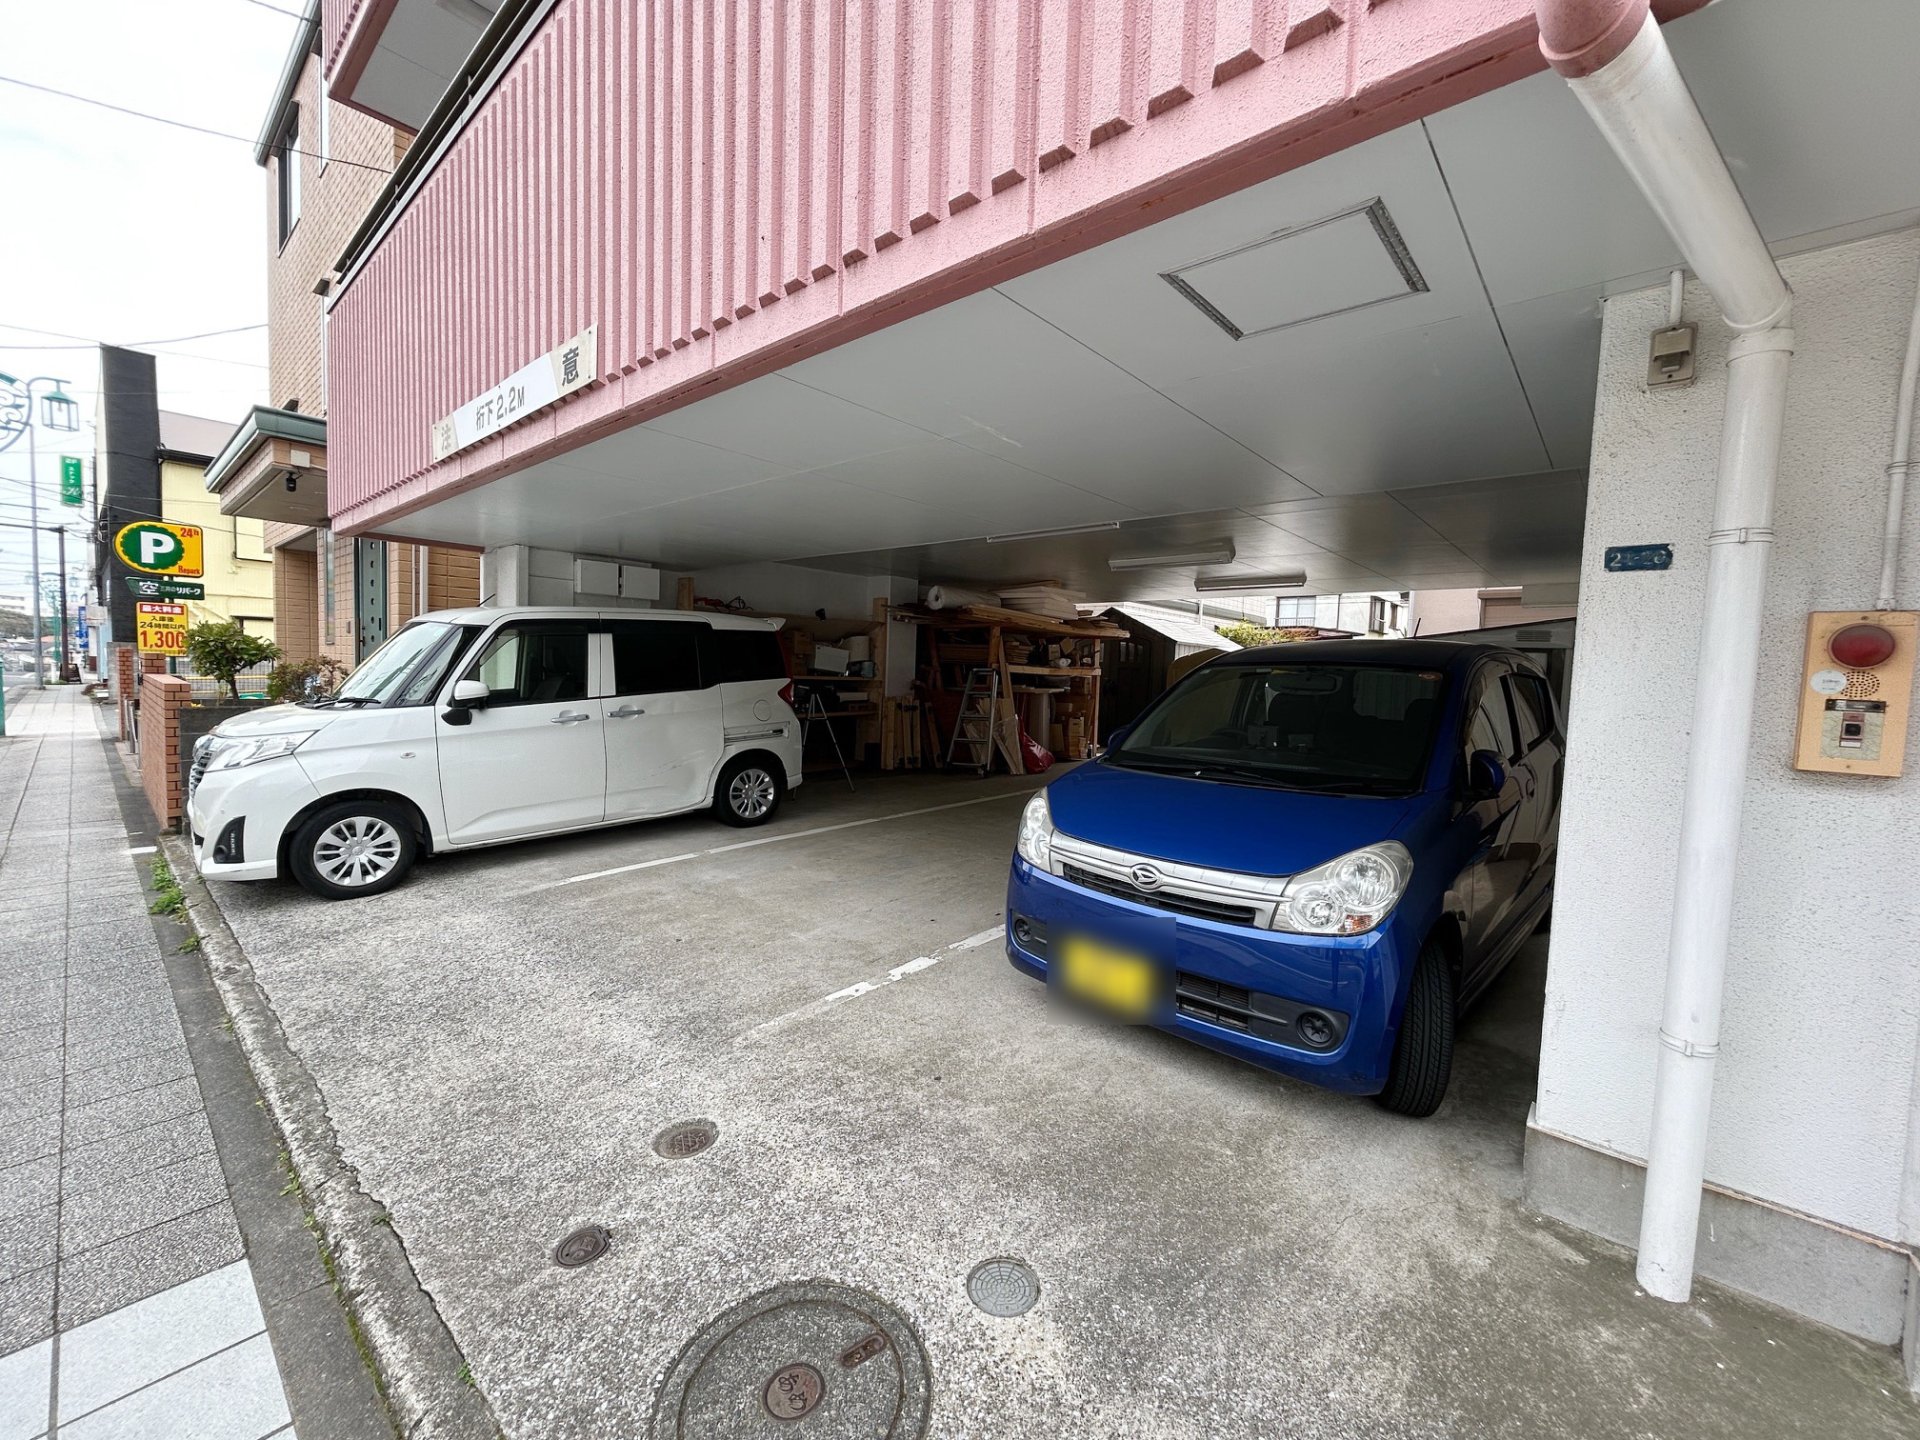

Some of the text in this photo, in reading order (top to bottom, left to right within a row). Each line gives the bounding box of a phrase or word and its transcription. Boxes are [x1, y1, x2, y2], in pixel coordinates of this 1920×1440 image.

[562, 346, 579, 387] 意
[140, 530, 175, 564] P
[139, 581, 159, 595] 空
